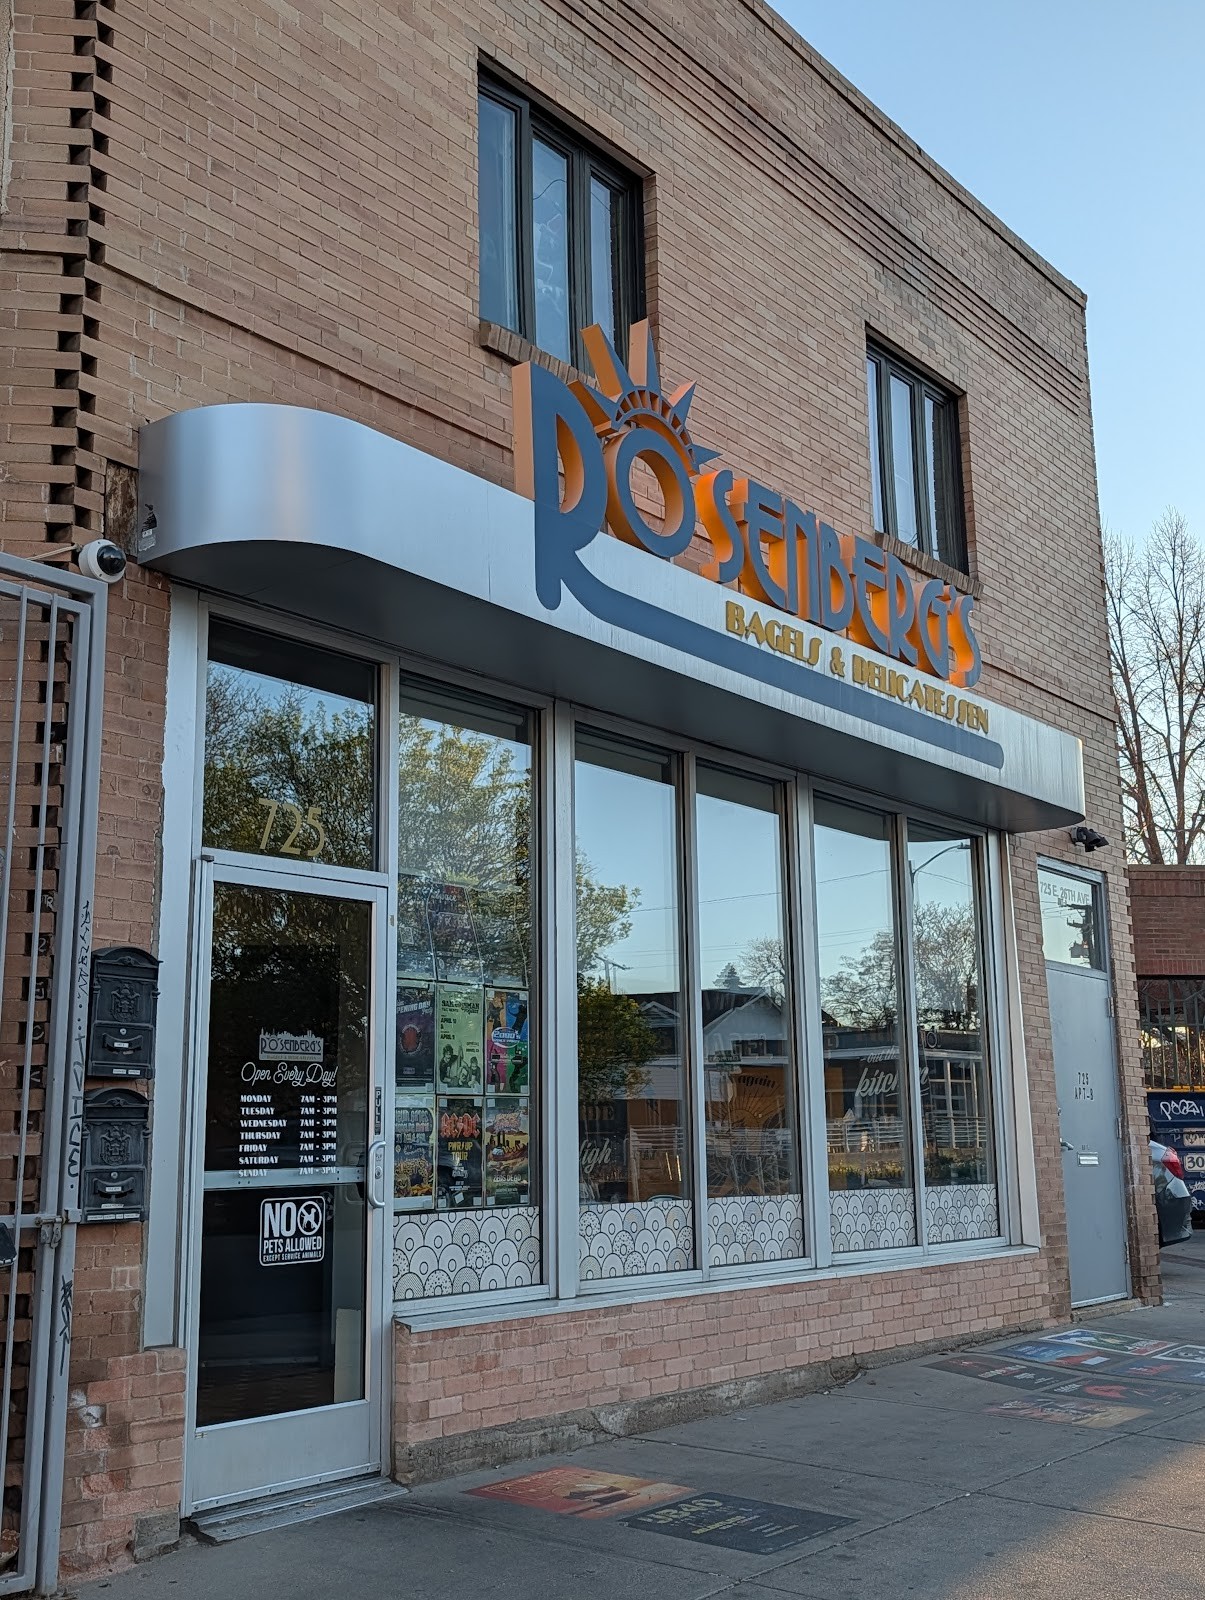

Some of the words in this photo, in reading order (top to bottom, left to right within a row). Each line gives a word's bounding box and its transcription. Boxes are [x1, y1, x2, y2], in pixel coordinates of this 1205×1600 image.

[512, 361, 984, 690] ROSENBERG'S
[726, 600, 823, 666] BAGELS
[830, 646, 846, 678] &
[852, 653, 988, 734] DELICATESSEN
[258, 797, 325, 857] 725
[1040, 881, 1052, 896] 725
[1077, 891, 1090, 904] AVE
[397, 1002, 418, 1014] PENING
[261, 1037, 322, 1054] ROSENBERG'S
[241, 1062, 272, 1087] Open
[273, 1062, 306, 1087] Every
[306, 1063, 339, 1087] Day!
[855, 1067, 929, 1097] kitcn
[1078, 1072, 1089, 1085] 725
[240, 1107, 275, 1115] TUESDAY
[240, 1119, 287, 1127] WEDNESDAY
[240, 1131, 281, 1140] THURSDAY
[239, 1144, 267, 1152] FRIDAY
[451, 1151, 469, 1160] TOUR
[239, 1156, 279, 1164] SATURDAY
[239, 1168, 268, 1177] SUNDAY
[263, 1202, 297, 1238] NO
[263, 1238, 284, 1254] PETS
[285, 1236, 322, 1252] ALLOWED
[263, 1254, 281, 1262] EXCEPT
[281, 1252, 300, 1261] SERVICE
[302, 1250, 322, 1259] ANIMALS
[637, 1498, 723, 1525] UB40
